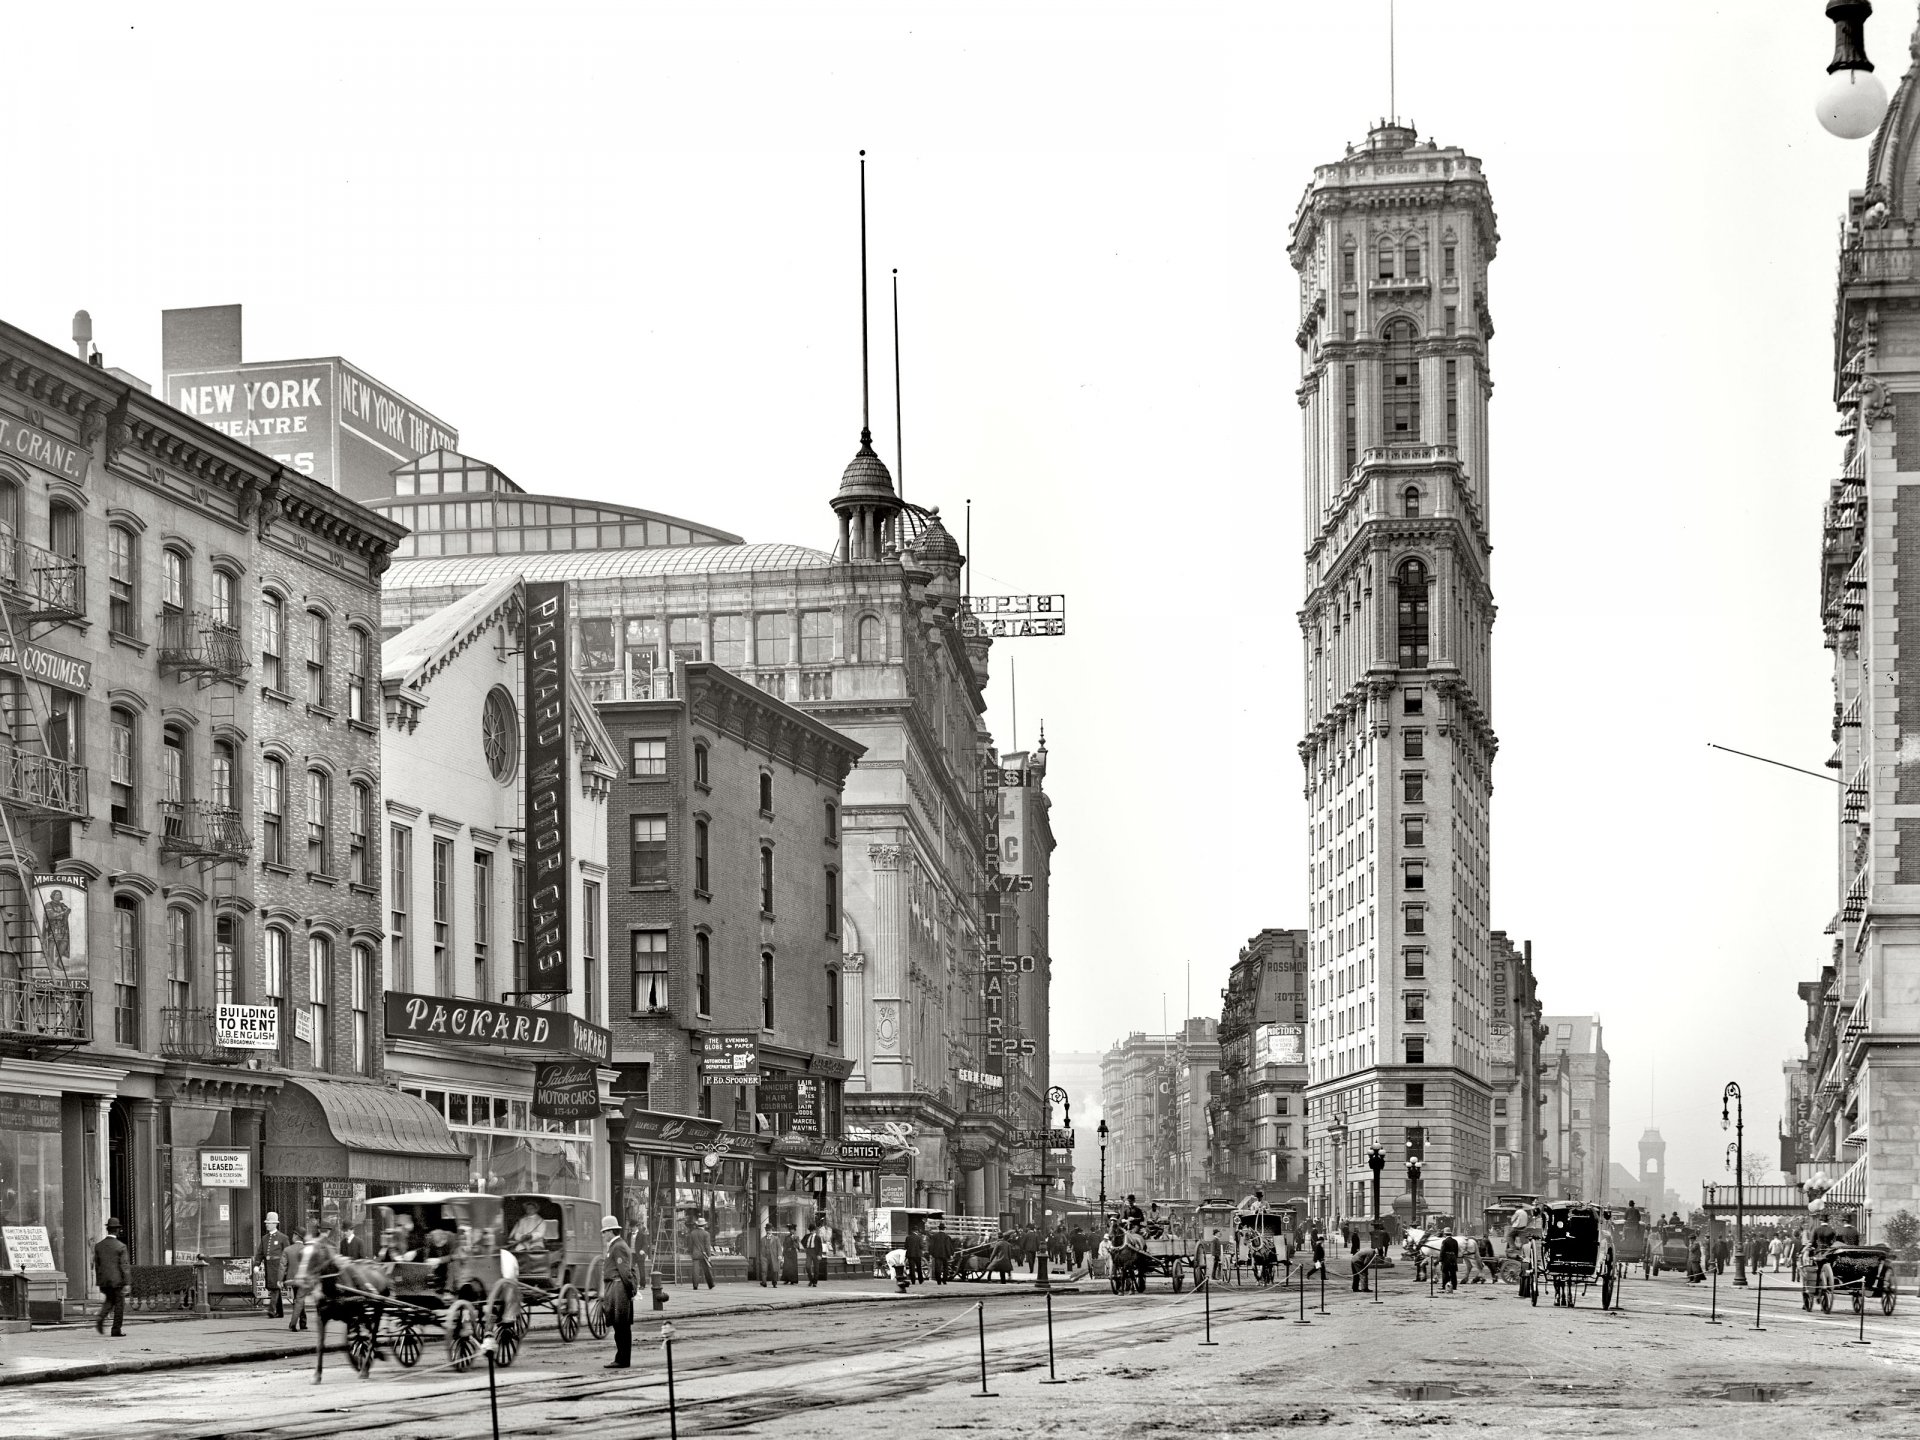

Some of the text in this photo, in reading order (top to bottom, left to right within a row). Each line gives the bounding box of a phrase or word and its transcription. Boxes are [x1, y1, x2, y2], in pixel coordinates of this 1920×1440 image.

[181, 378, 323, 415] NEW YORK
[343, 372, 371, 423] NEW
[372, 389, 405, 444] YORK
[208, 416, 308, 437] HEATRE
[16, 428, 79, 477] CRANE.
[23, 646, 86, 689] COSTUMES.
[530, 594, 564, 973] PACKARD MOTOR CARS
[34, 875, 88, 890] MME. CRANE.
[1001, 874, 1034, 893] 75
[983, 748, 1003, 1057] NEW YORK THEATRE
[1002, 955, 1036, 974] 50
[1274, 992, 1307, 1002] HOTEL
[220, 1006, 276, 1019] BUILDING
[405, 998, 550, 1044] PACKARD
[218, 1017, 276, 1032] TO RENT
[233, 1031, 276, 1041] ENGLISH
[573, 1020, 608, 1058] PACKARD
[1003, 1038, 1037, 1057] 25
[537, 1065, 593, 1089] Packard
[725, 1076, 759, 1085] SPOONER
[538, 1089, 597, 1105] MOTOR CARS
[765, 1094, 787, 1102] HAIR
[553, 1107, 580, 1116] 1540
[760, 1102, 794, 1110] COLORING
[1008, 1130, 1032, 1142] NEW
[841, 1146, 881, 1158] DENTIST.
[208, 1163, 235, 1171] LEASED.
